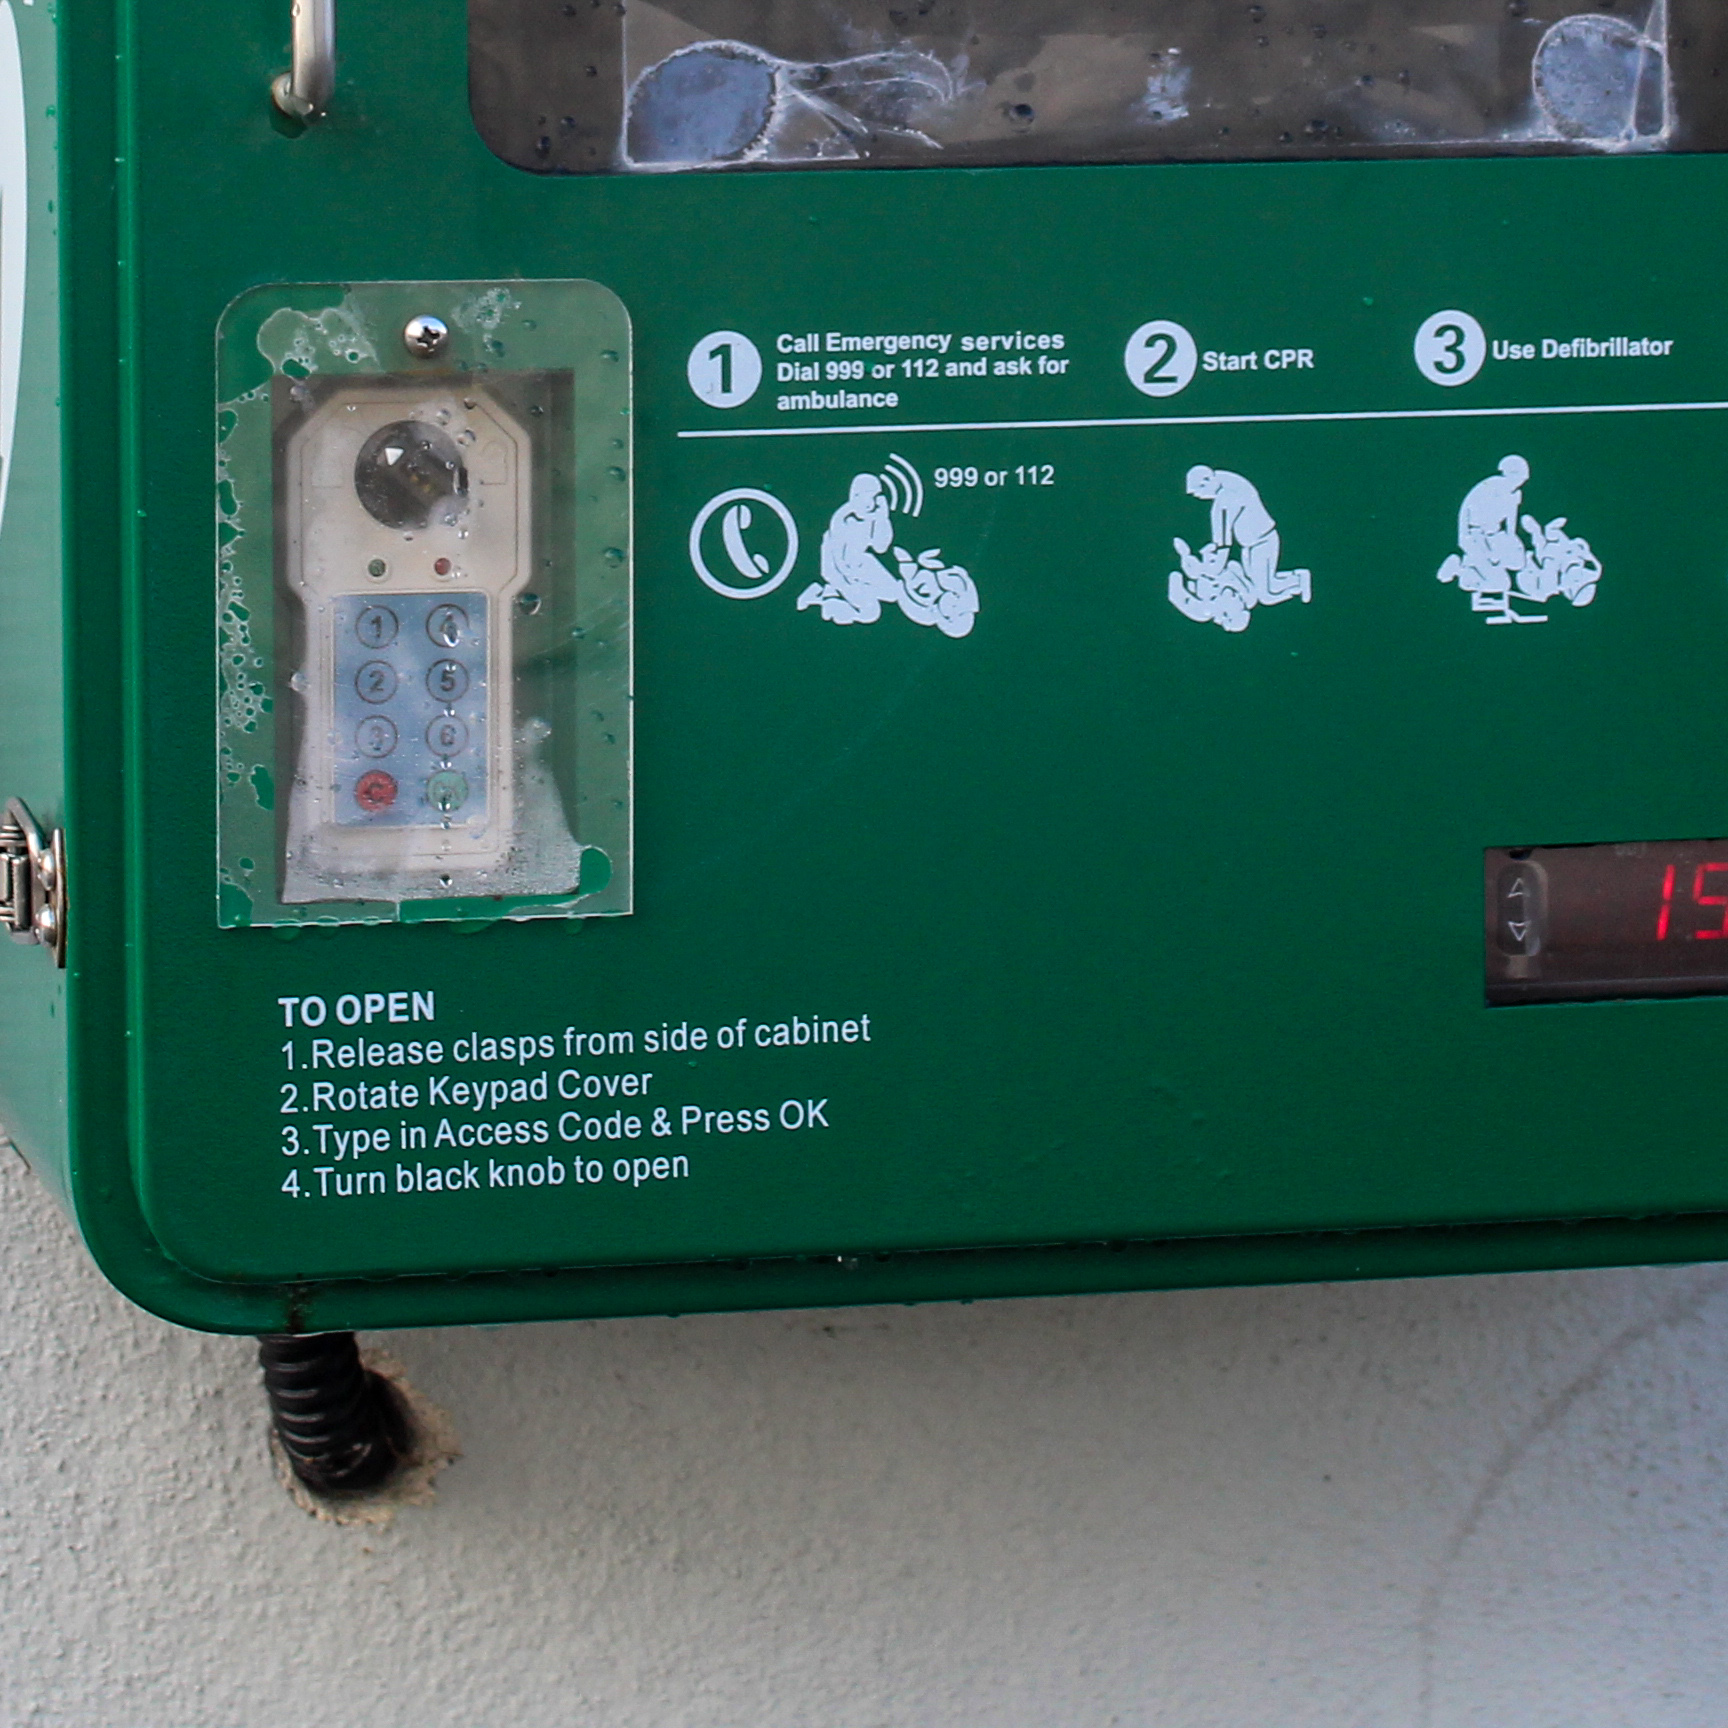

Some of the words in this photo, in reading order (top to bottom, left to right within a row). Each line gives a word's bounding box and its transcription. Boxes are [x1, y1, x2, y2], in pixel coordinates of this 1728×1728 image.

[777, 334, 819, 353] Call
[826, 333, 951, 354] Emergency
[962, 331, 1064, 351] services
[1434, 325, 1465, 374] 3
[1493, 340, 1535, 359] Use
[1543, 337, 1673, 358] Defibrillator
[709, 344, 731, 393] 1
[778, 362, 819, 381] Dial
[826, 361, 864, 380] 999
[872, 364, 895, 378] or
[902, 359, 938, 377] 112
[946, 357, 986, 376] and
[994, 357, 1032, 375] ask
[1038, 356, 1069, 374] for
[1144, 333, 1177, 383] 2
[1203, 352, 1257, 371] Start
[1264, 350, 1313, 369] CPR
[778, 390, 898, 410] ambulance
[935, 467, 978, 487] 999
[985, 472, 1007, 486] or
[1016, 465, 1054, 484] 112
[368, 670, 384, 693] 2
[440, 668, 456, 692] 5
[278, 997, 326, 1027] TO
[337, 992, 433, 1025] OPEN
[454, 1032, 554, 1065] clasps
[563, 1026, 634, 1056] from
[645, 1022, 707, 1052] side
[718, 1019, 746, 1048] of
[755, 1015, 870, 1046] cabinet
[430, 1072, 546, 1109] Keypad
[558, 1070, 652, 1099] Cover
[401, 1121, 425, 1149] in
[434, 1119, 548, 1147] Access
[559, 1111, 641, 1141] Code
[652, 1108, 671, 1136] &
[683, 1106, 770, 1134] Press
[780, 1100, 828, 1129] OK
[397, 1161, 479, 1192] black
[490, 1156, 564, 1187] knob
[574, 1156, 602, 1183] to
[614, 1156, 688, 1187] open
